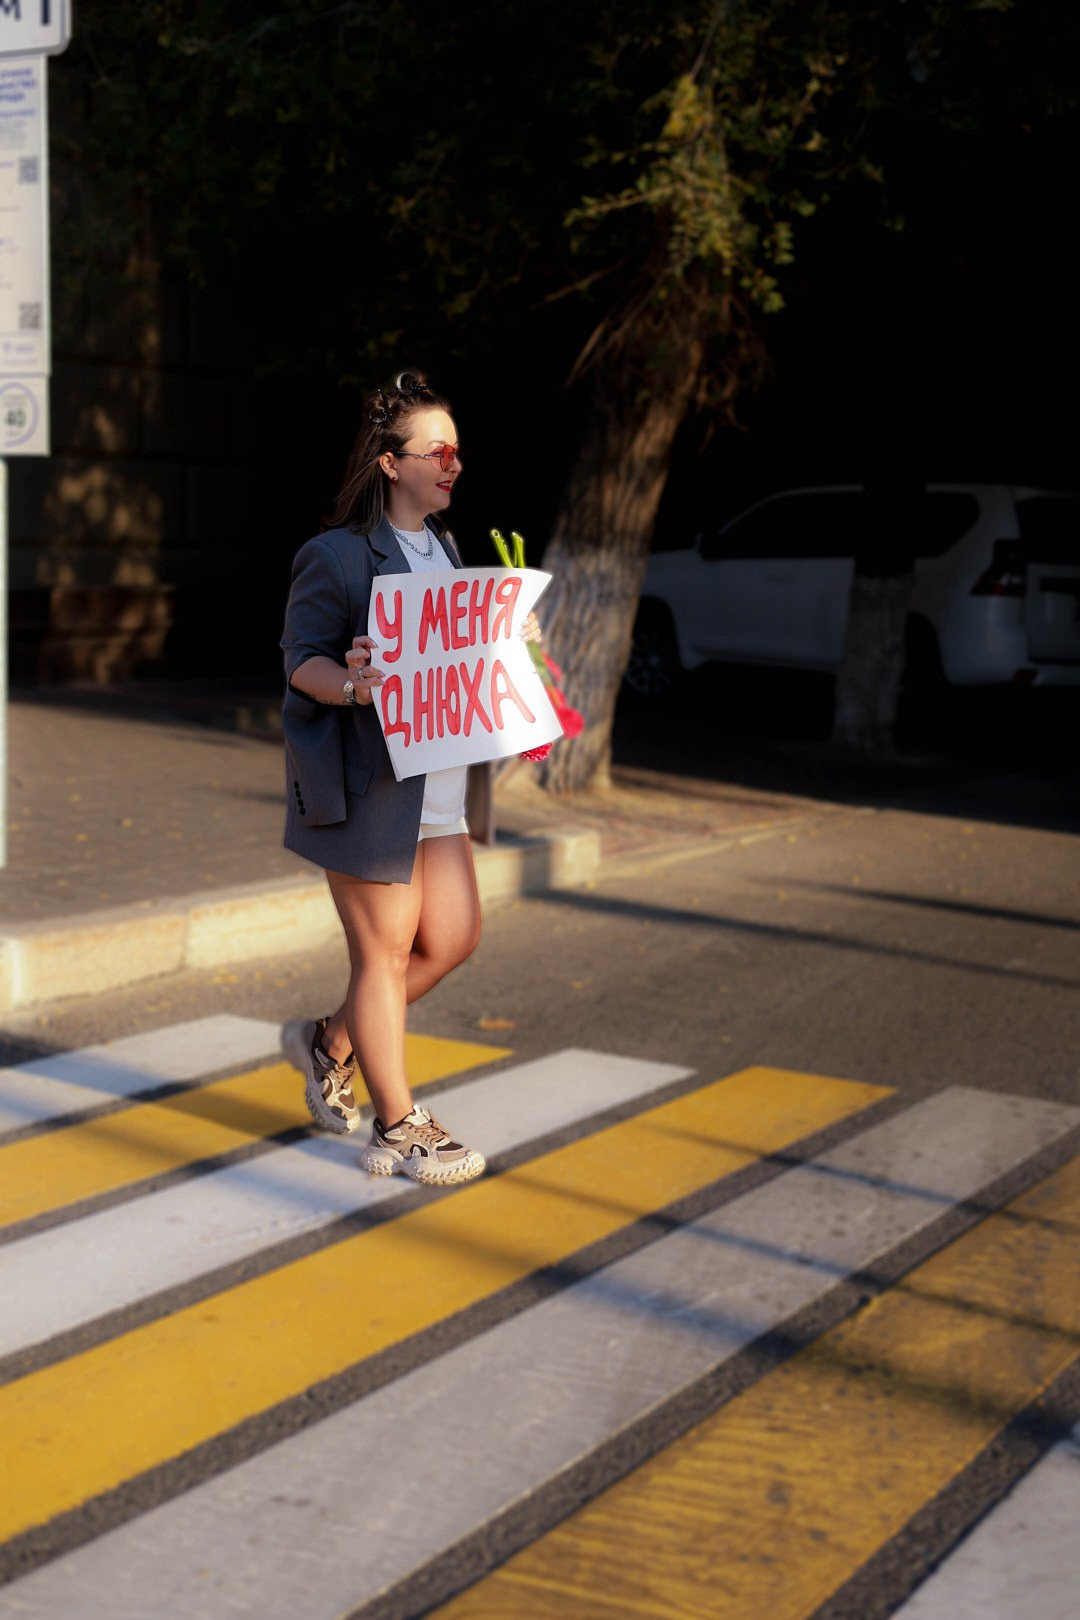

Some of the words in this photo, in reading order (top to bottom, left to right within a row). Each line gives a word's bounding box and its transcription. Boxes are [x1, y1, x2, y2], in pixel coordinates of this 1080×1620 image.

[375, 589, 403, 663] У
[418, 577, 523, 655] МЕНЯ
[381, 657, 536, 748] ДНЮХА
